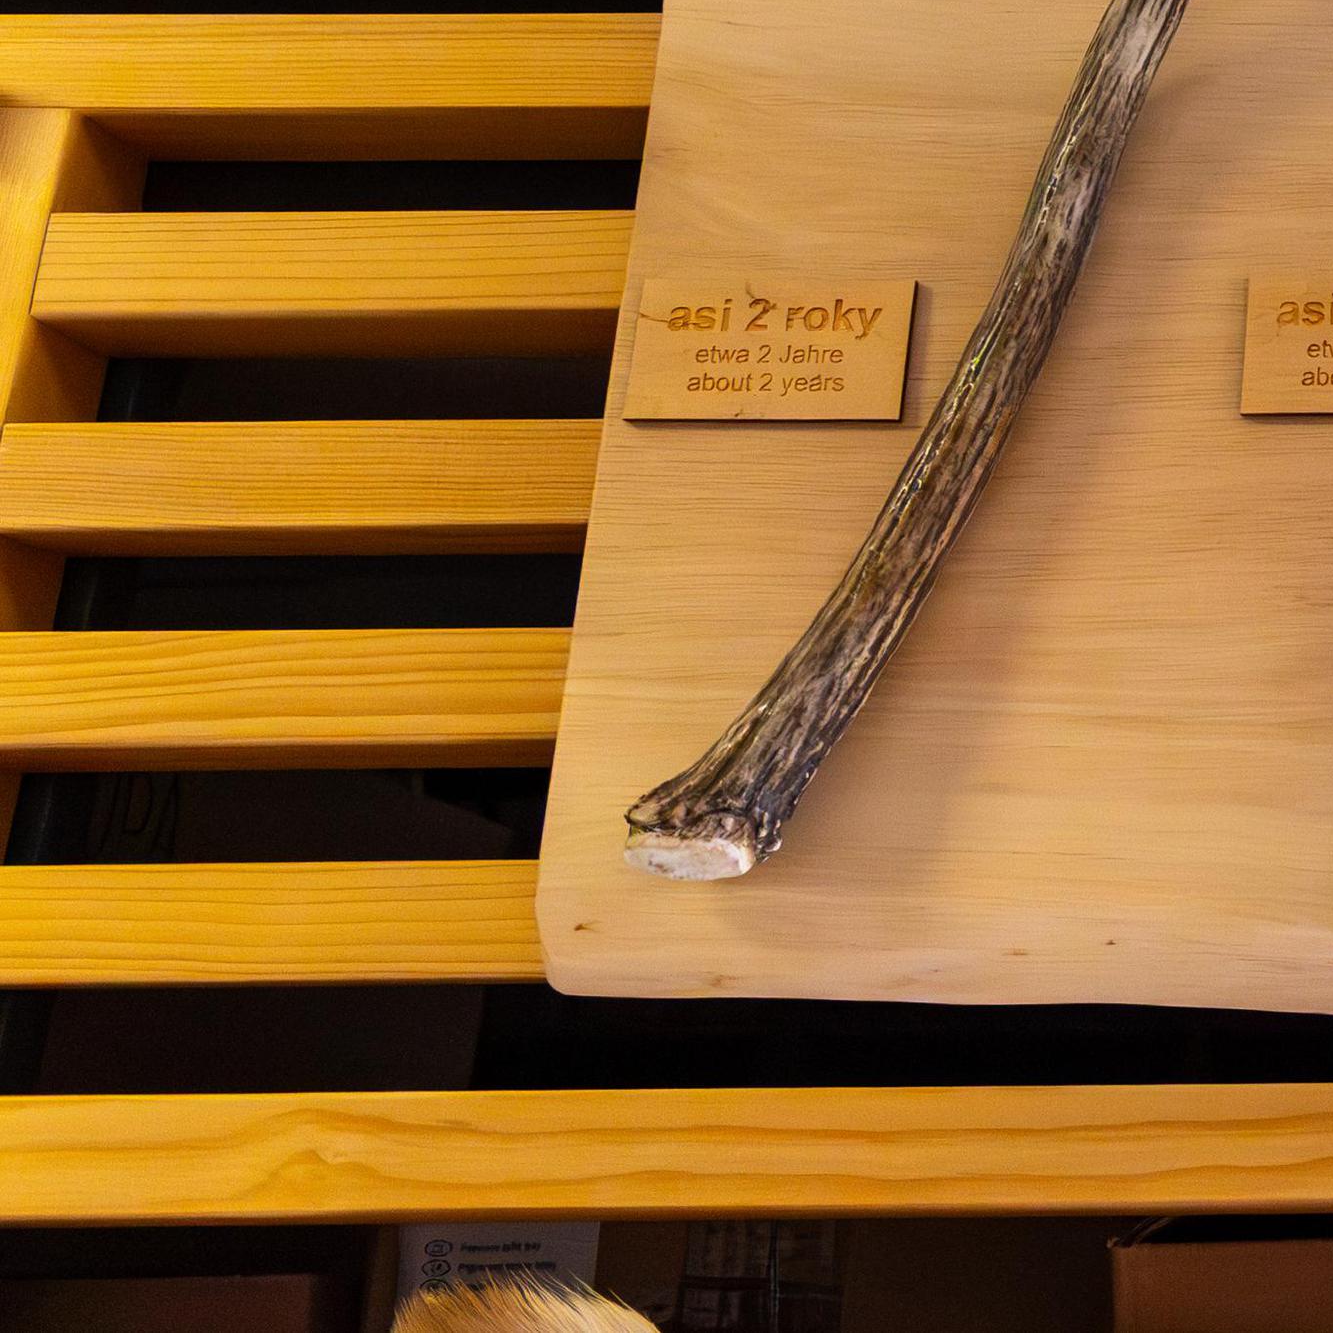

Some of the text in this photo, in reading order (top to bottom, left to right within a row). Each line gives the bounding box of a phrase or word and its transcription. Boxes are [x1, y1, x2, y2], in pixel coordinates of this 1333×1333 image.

[666, 298, 882, 340] asi 2 roky
[695, 344, 844, 364] etwa 2 Jahre
[687, 372, 845, 396] about 2 years
